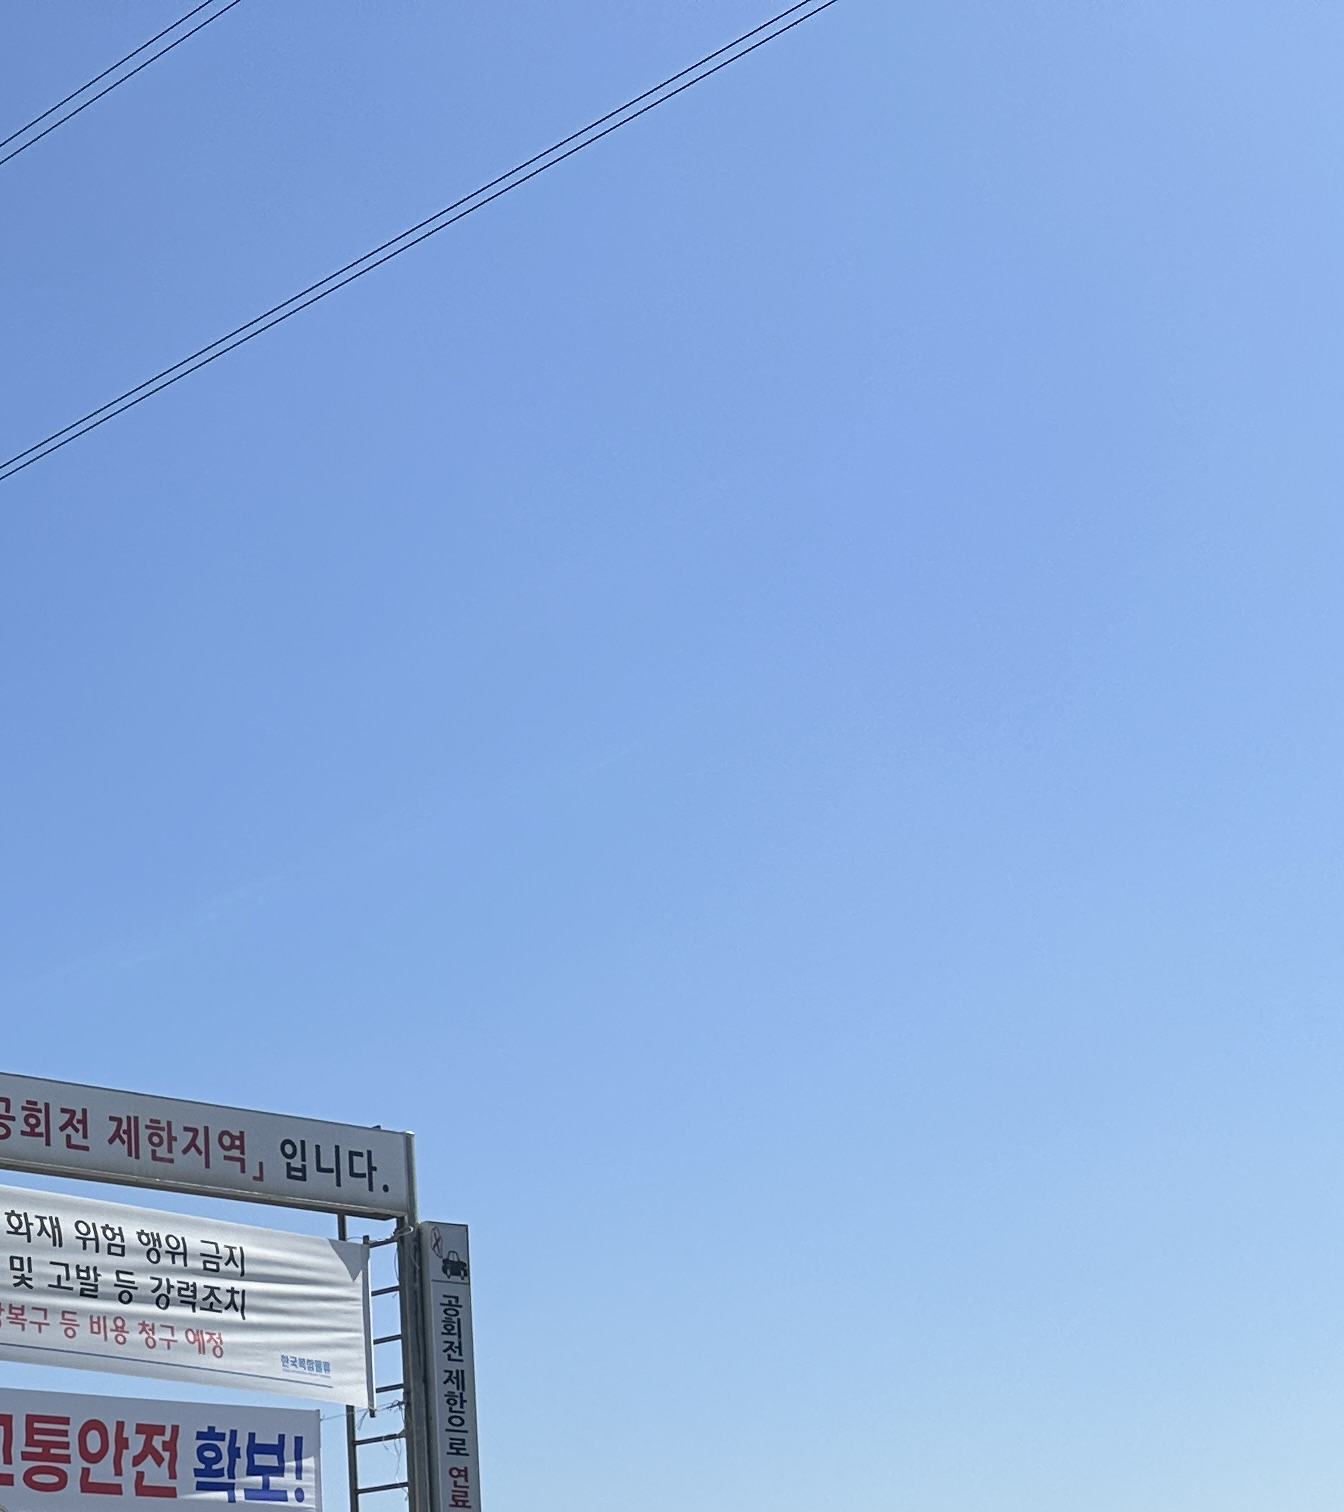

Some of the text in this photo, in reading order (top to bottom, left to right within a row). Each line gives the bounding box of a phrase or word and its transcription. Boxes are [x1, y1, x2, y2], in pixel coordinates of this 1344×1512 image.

[279, 1138, 390, 1193] 입니다.
[4, 1208, 63, 1248] 화재
[74, 1219, 126, 1257] 위험
[136, 1228, 189, 1267] 행위
[199, 1239, 246, 1278] 금지
[9, 1255, 34, 1291] 및
[47, 1260, 102, 1299] 고발
[113, 1270, 140, 1305] 등
[149, 1275, 247, 1320] 강력조치
[58, 1309, 81, 1339] 등
[89, 1313, 129, 1346] 비용
[137, 1319, 178, 1351] 청구
[184, 1327, 224, 1359] 예정
[439, 1294, 464, 1363] 공회전
[192, 1425, 304, 1503] 확보!
